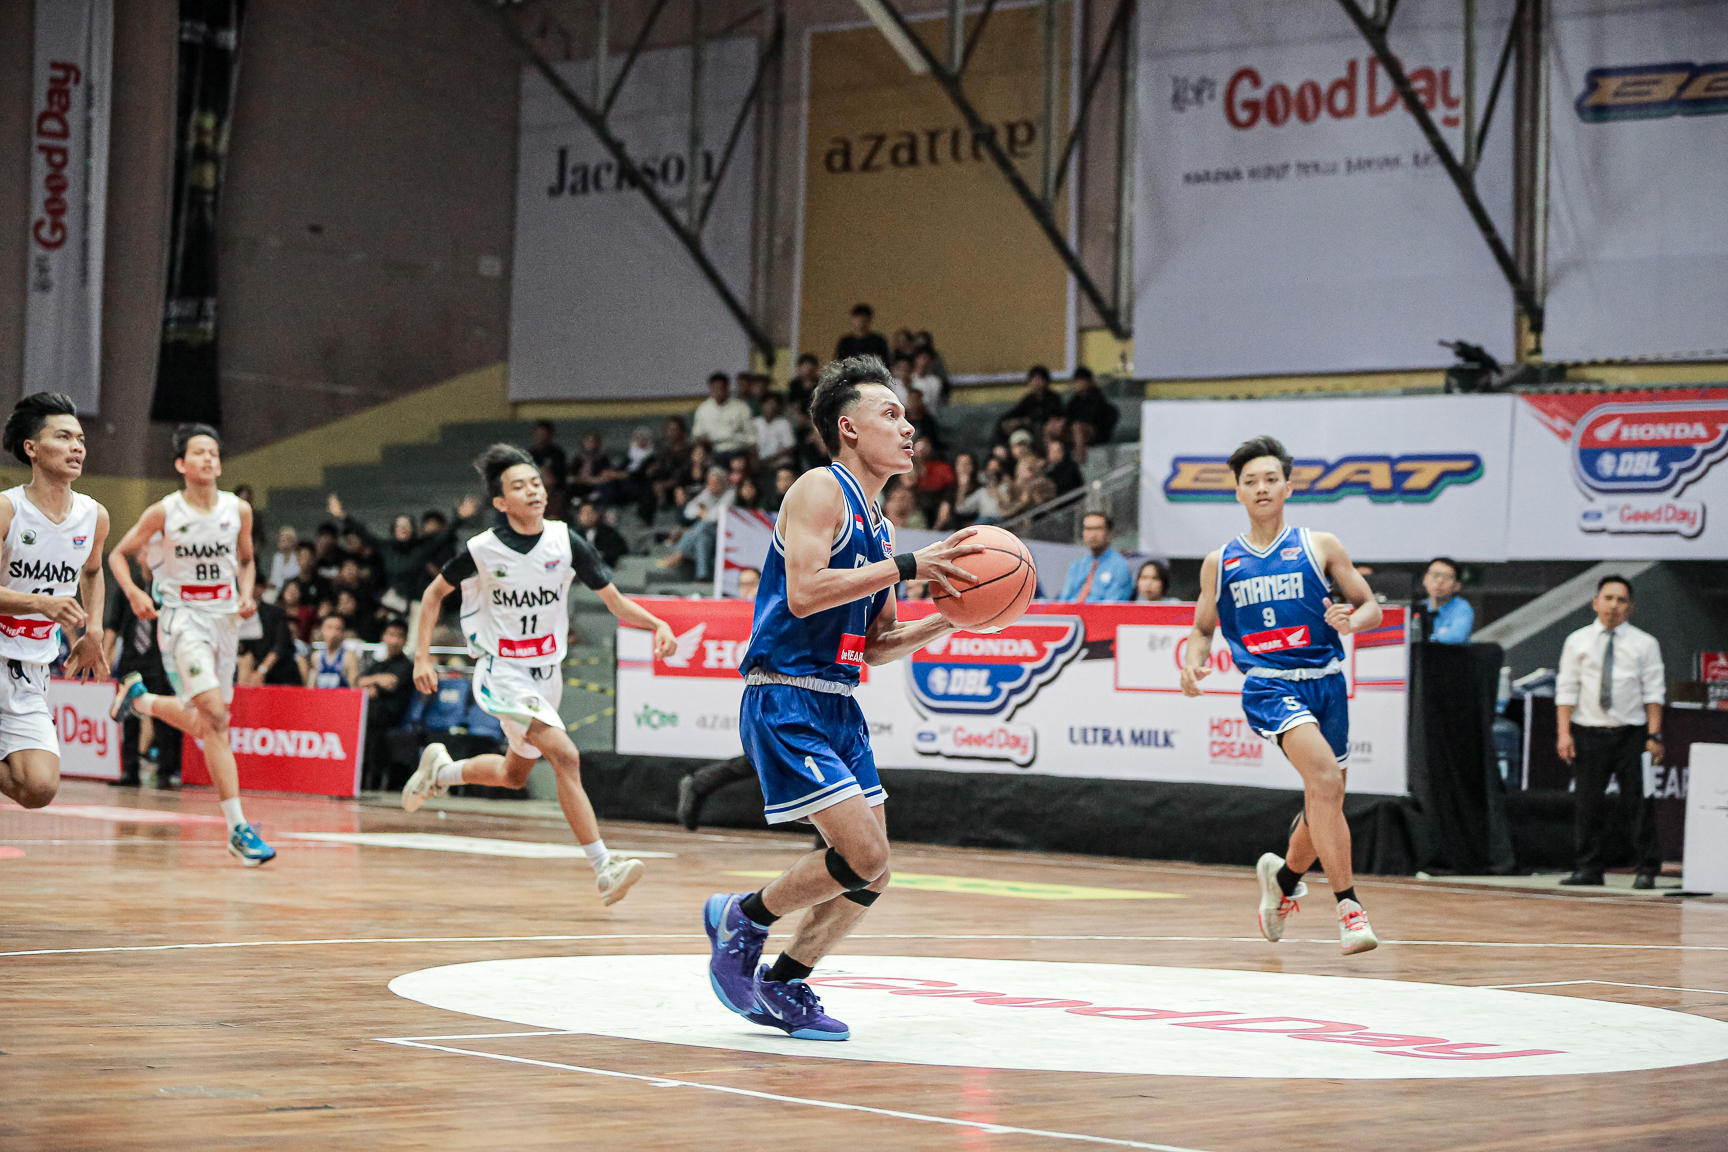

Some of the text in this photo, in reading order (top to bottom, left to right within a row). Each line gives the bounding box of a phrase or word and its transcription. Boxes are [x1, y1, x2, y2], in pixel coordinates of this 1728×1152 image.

[1620, 422, 1708, 441] HONDA
[1616, 451, 1661, 477] DBL
[1167, 457, 1479, 497] BAT
[1229, 571, 1305, 608] SMANSA
[520, 614, 538, 635] 11
[1262, 607, 1276, 628] 9
[950, 638, 1037, 657] HONDA
[948, 668, 993, 696] DBL
[1283, 695, 1302, 711] 5
[62, 704, 108, 757] Day
[1068, 726, 1176, 749] ULTRA MILK
[1209, 718, 1243, 738] HOT
[229, 727, 347, 761] HONDA
[1209, 740, 1263, 760] CREAM
[804, 755, 826, 783] 1
